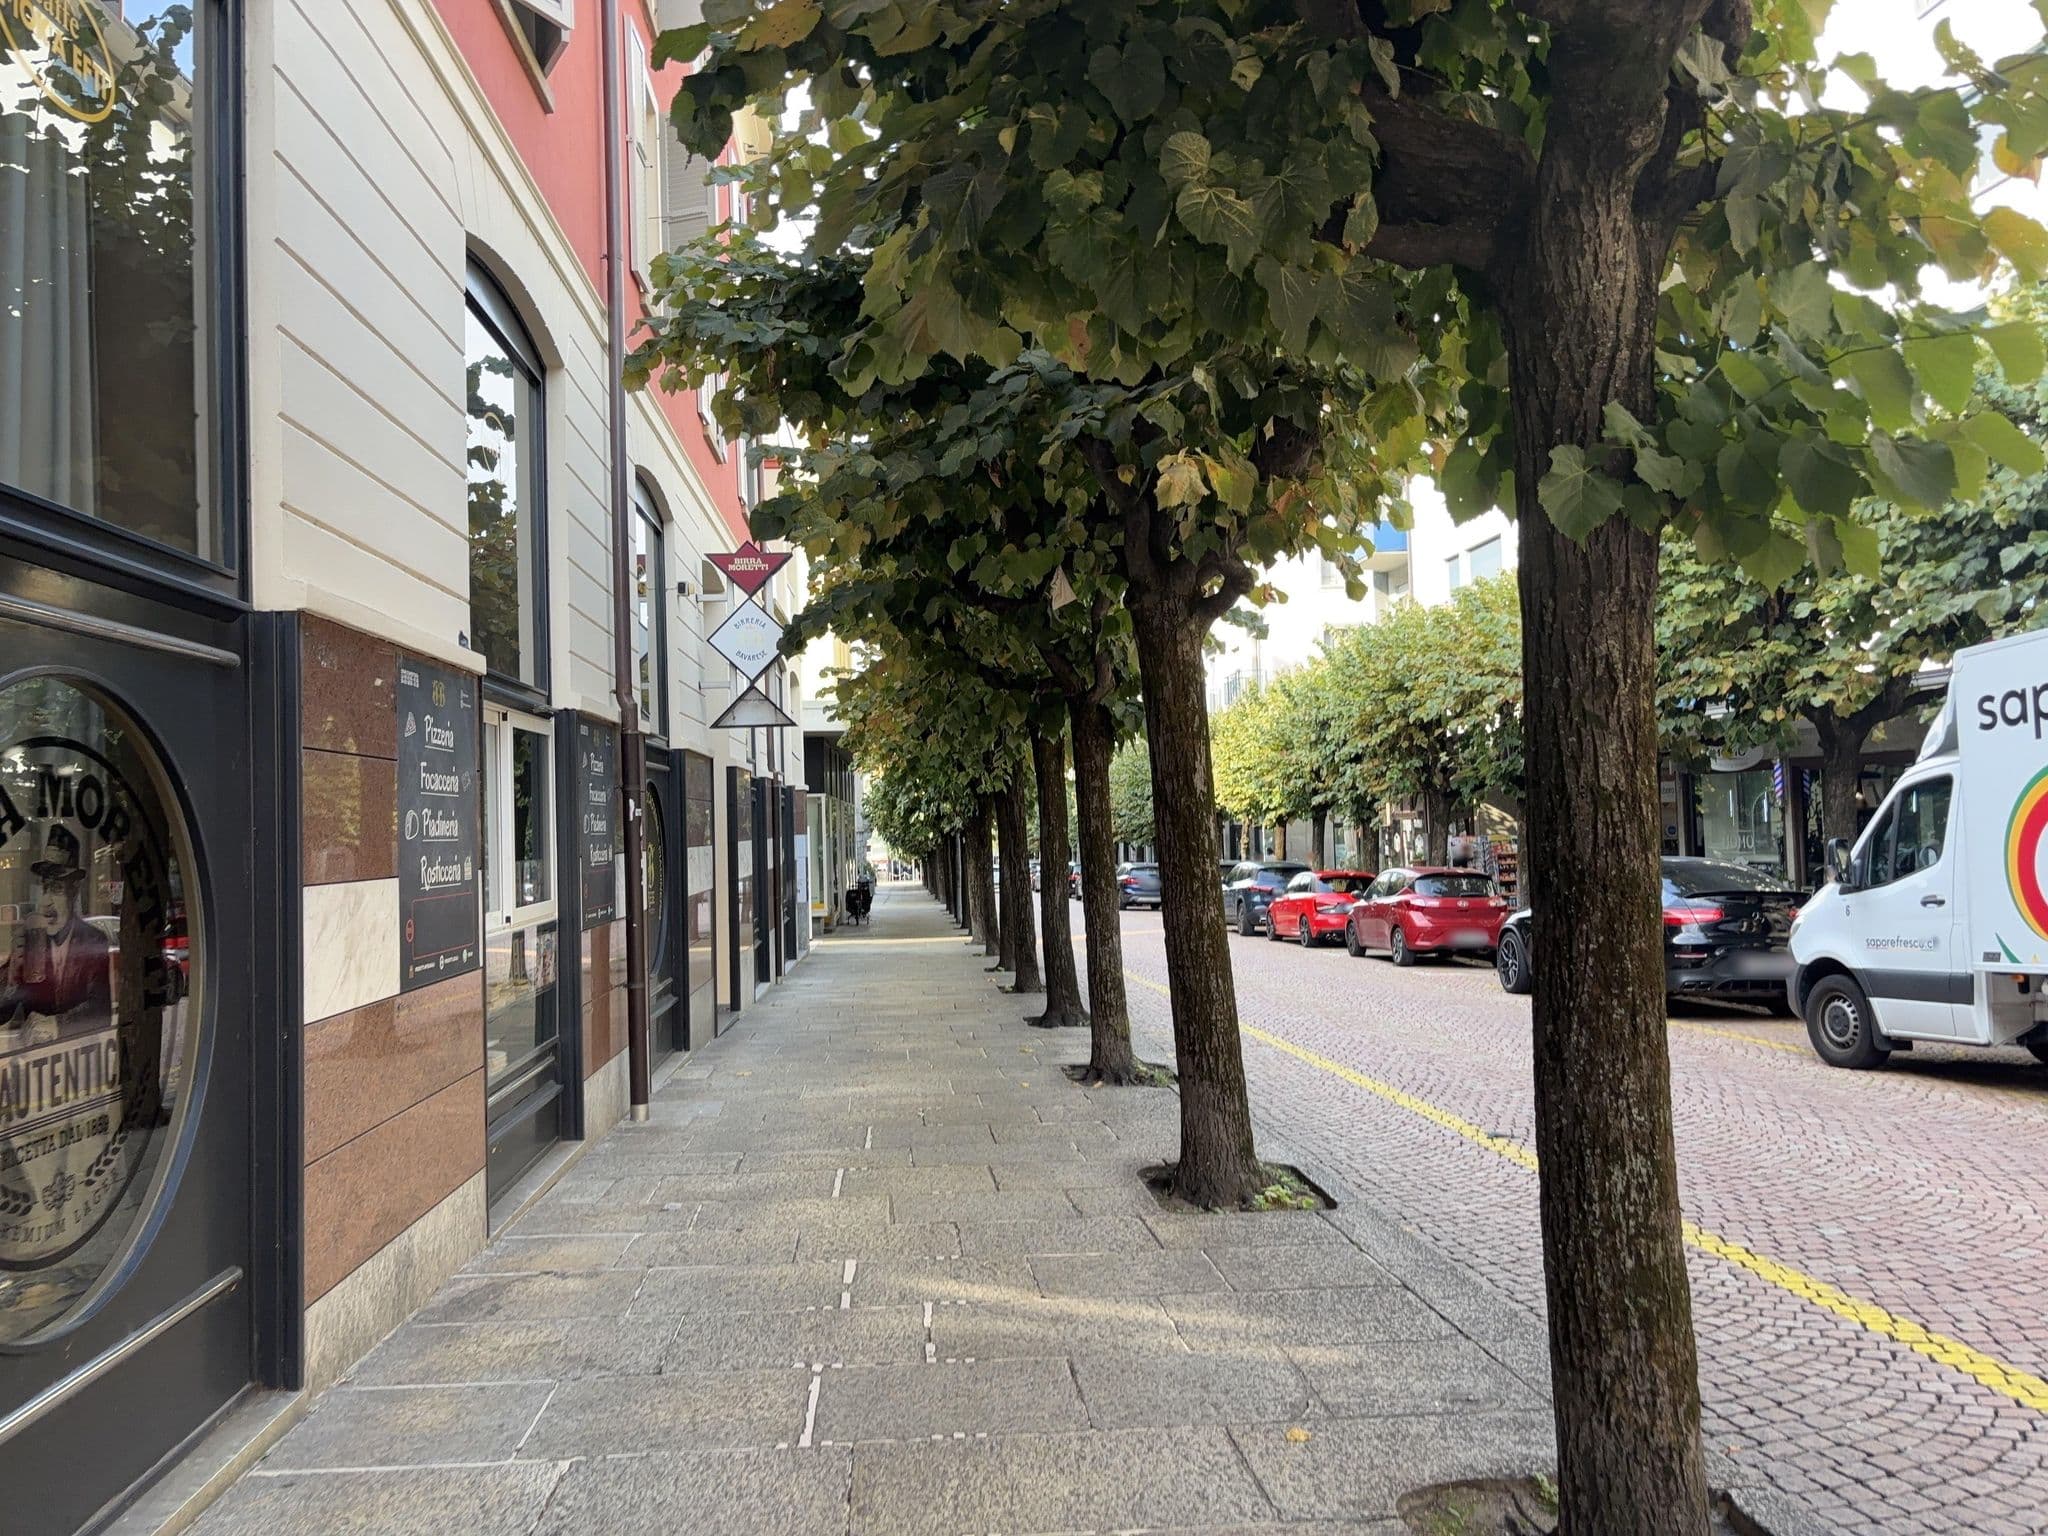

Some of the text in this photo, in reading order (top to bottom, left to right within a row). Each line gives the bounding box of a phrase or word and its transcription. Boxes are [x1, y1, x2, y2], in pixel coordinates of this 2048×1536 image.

[424, 714, 454, 748] Pizzeria
[420, 761, 459, 793] Focacceria
[422, 808, 459, 838] Piadineria
[420, 855, 461, 891] Rosticceria
[1845, 905, 1850, 917] 6
